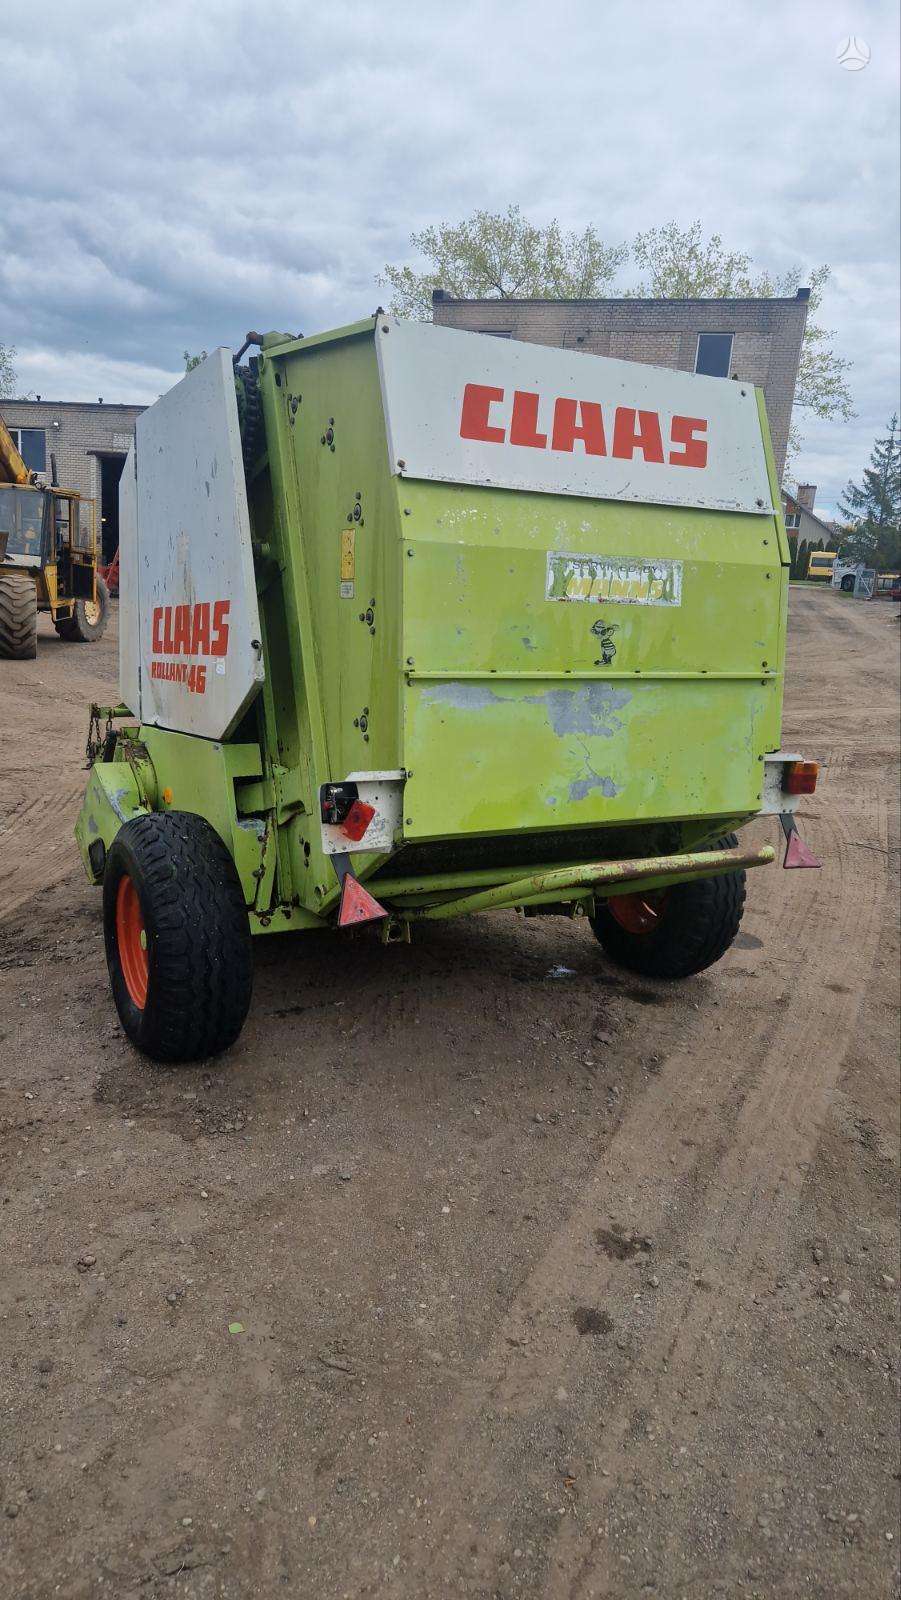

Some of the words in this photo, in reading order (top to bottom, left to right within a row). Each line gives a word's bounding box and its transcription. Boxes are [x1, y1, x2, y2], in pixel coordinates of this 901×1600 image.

[460, 383, 708, 469] CLAAS
[572, 561, 636, 573] SERVIED
[152, 600, 230, 656] CLAAS
[151, 661, 188, 683] ROLLANT
[187, 664, 207, 694] 46
